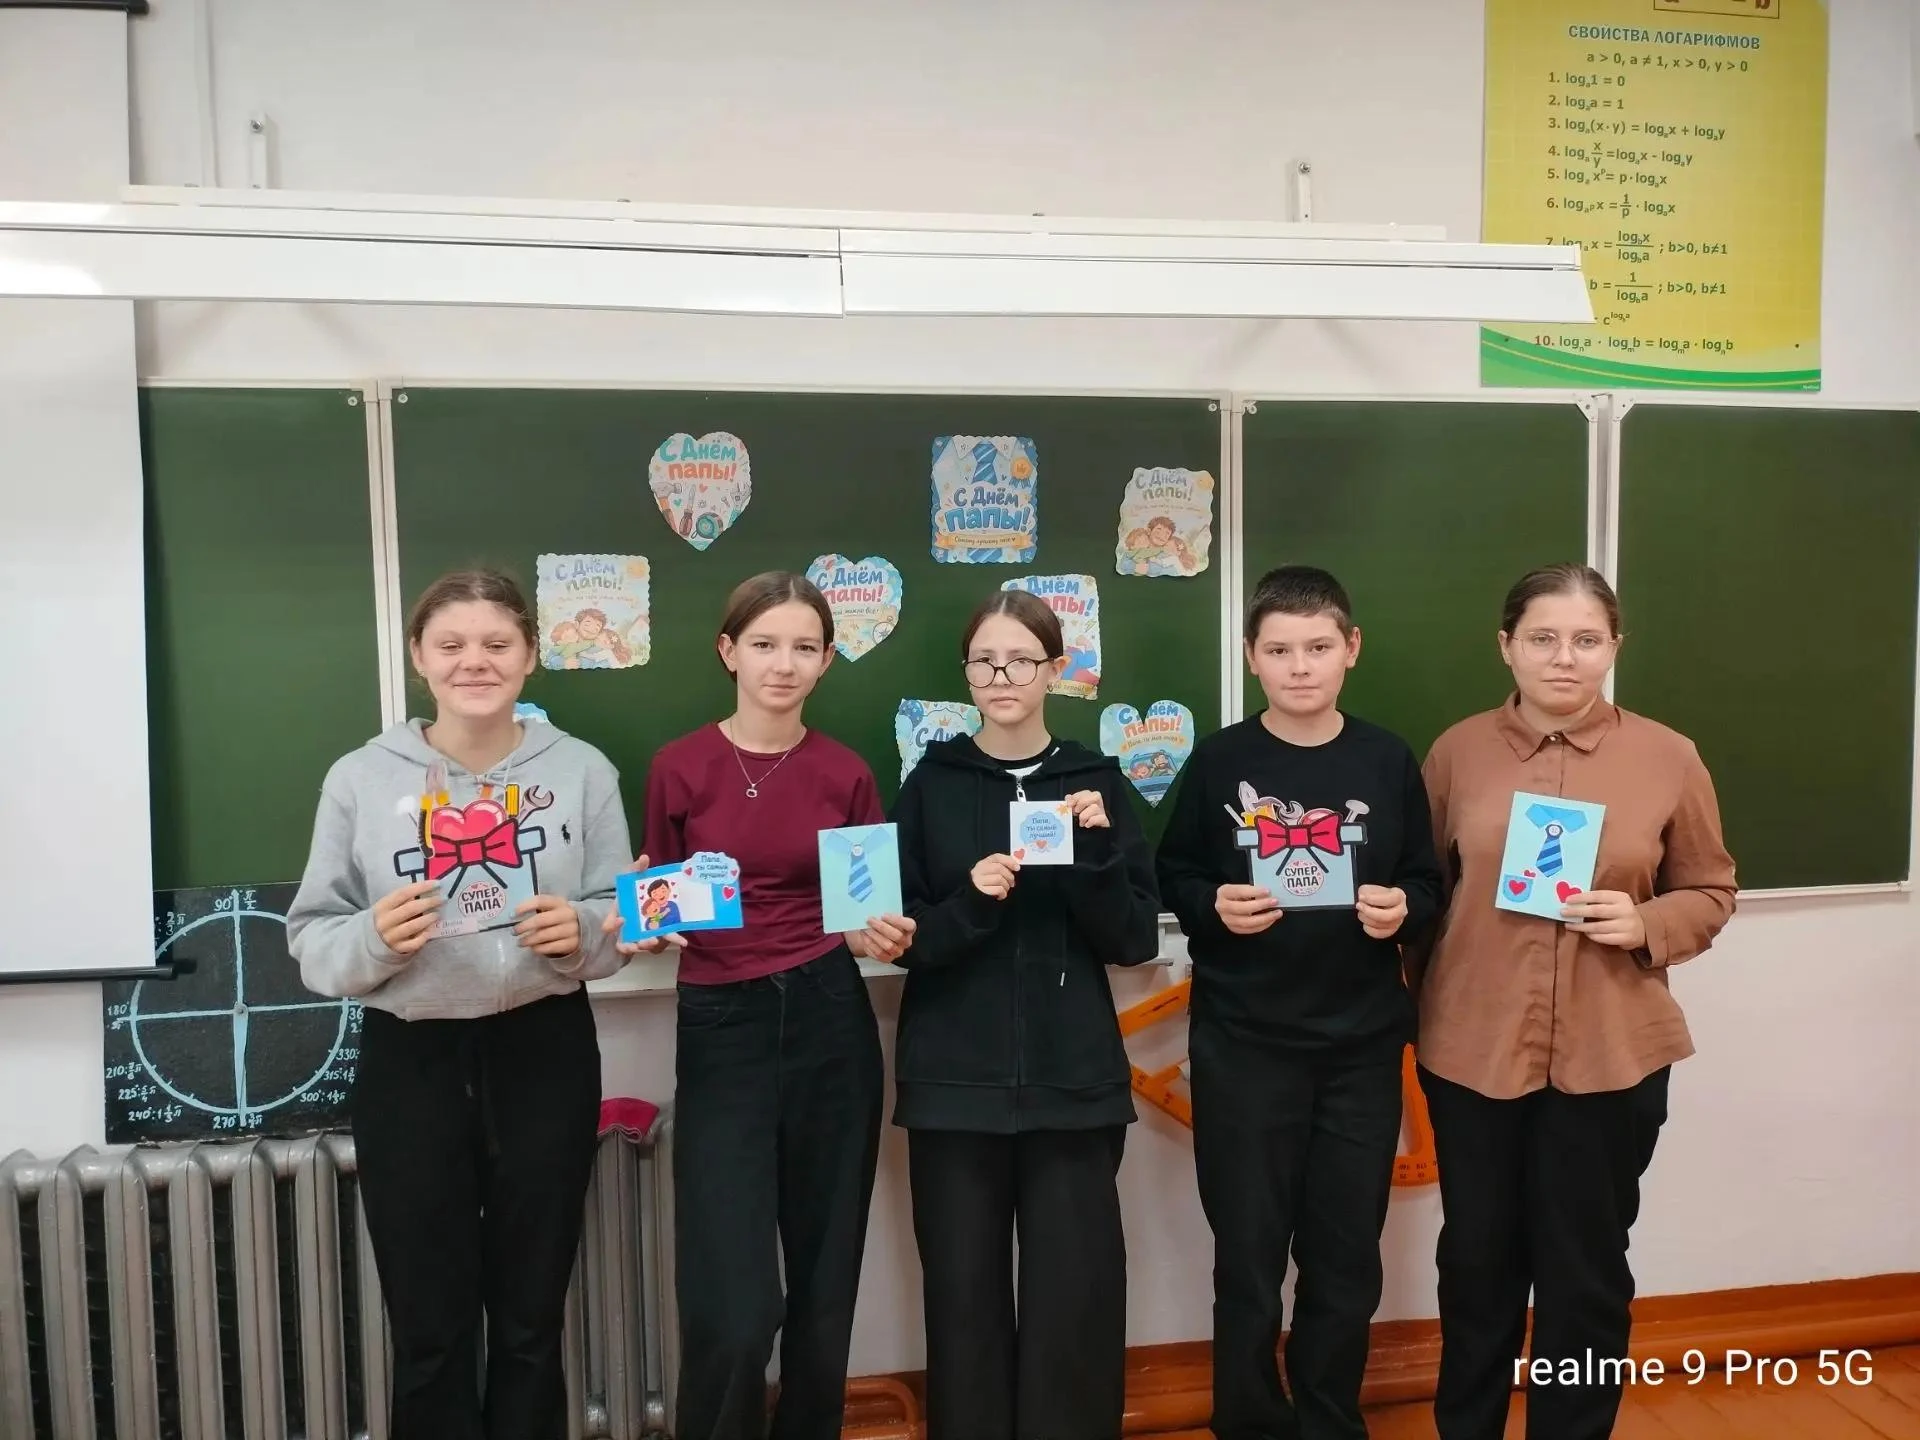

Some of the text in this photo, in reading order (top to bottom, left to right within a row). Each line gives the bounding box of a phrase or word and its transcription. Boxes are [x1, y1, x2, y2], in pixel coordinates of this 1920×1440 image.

[1568, 24, 1760, 50] СВОЙСТВА ЛОГАРИФМОВ
[1548, 72, 1560, 83] 1.
[1548, 95, 1560, 106] 2.
[1548, 118, 1561, 129] 3.
[1548, 146, 1560, 157] 4.
[1548, 168, 1560, 180] 5.
[1547, 197, 1559, 209] 6.
[1535, 335, 1555, 347] 10.
[660, 436, 737, 462] С Днём
[954, 486, 1019, 508] С Днём
[816, 565, 883, 591] С Днём
[1026, 575, 1080, 596] Днём
[1118, 707, 1133, 725] С
[916, 727, 929, 748] С
[1285, 865, 1318, 877] СУПЕР
[1287, 876, 1320, 888] ПАПА
[461, 886, 500, 902] СУПЕР
[464, 898, 502, 914] ПАПА
[348, 1007, 364, 1020] 36
